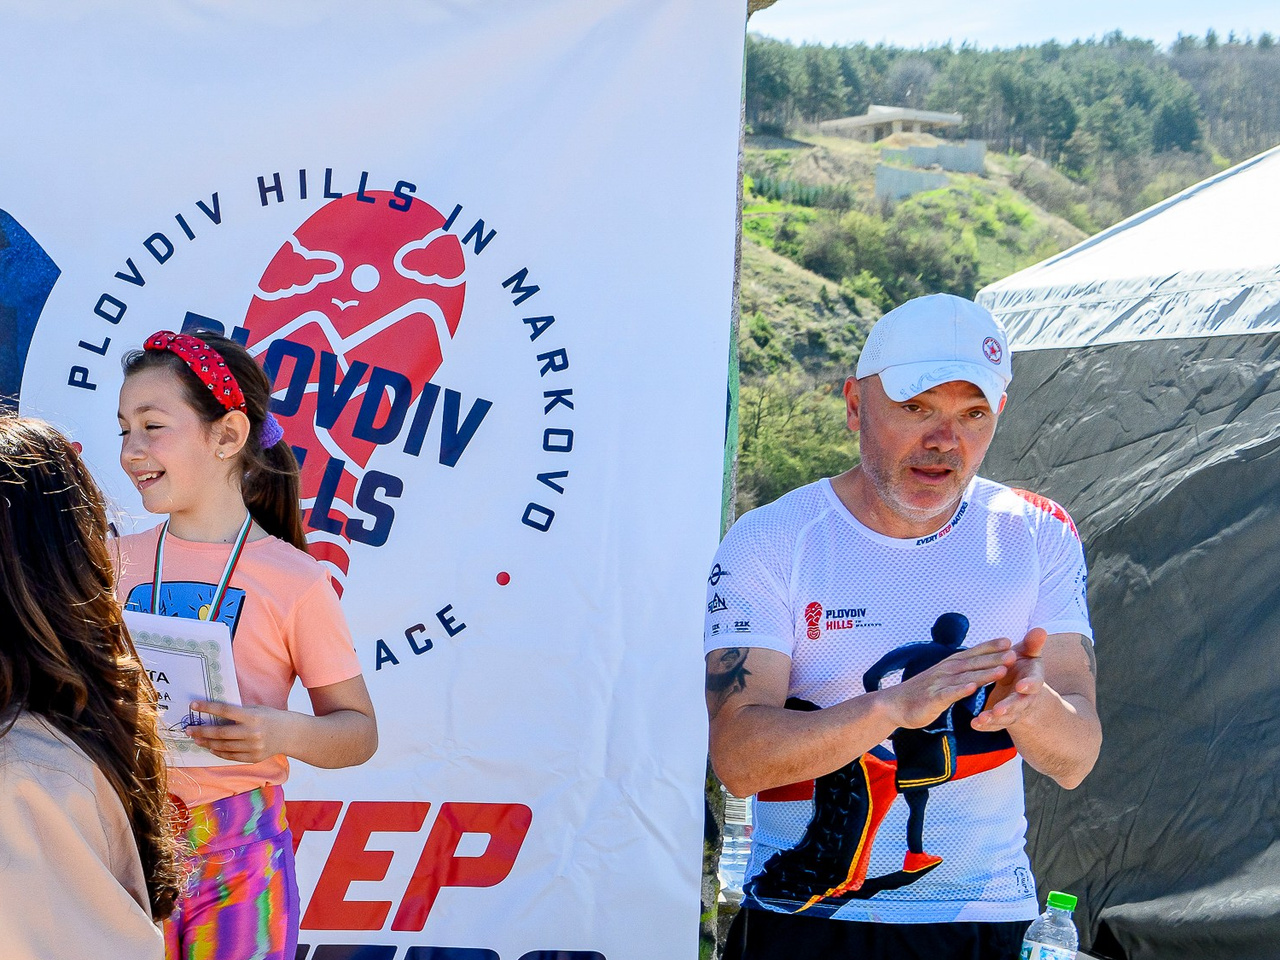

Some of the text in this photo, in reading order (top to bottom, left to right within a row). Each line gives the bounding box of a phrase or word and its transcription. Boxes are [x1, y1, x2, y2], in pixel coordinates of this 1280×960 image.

[68, 168, 575, 532] PLOVDIV HILLS IN MARKOVO
[180, 311, 494, 468] OVDIV
[375, 603, 467, 671] ACE
[826, 608, 866, 619] PLOVDIV
[826, 620, 853, 630] HILLS
[285, 801, 532, 931] TEP
